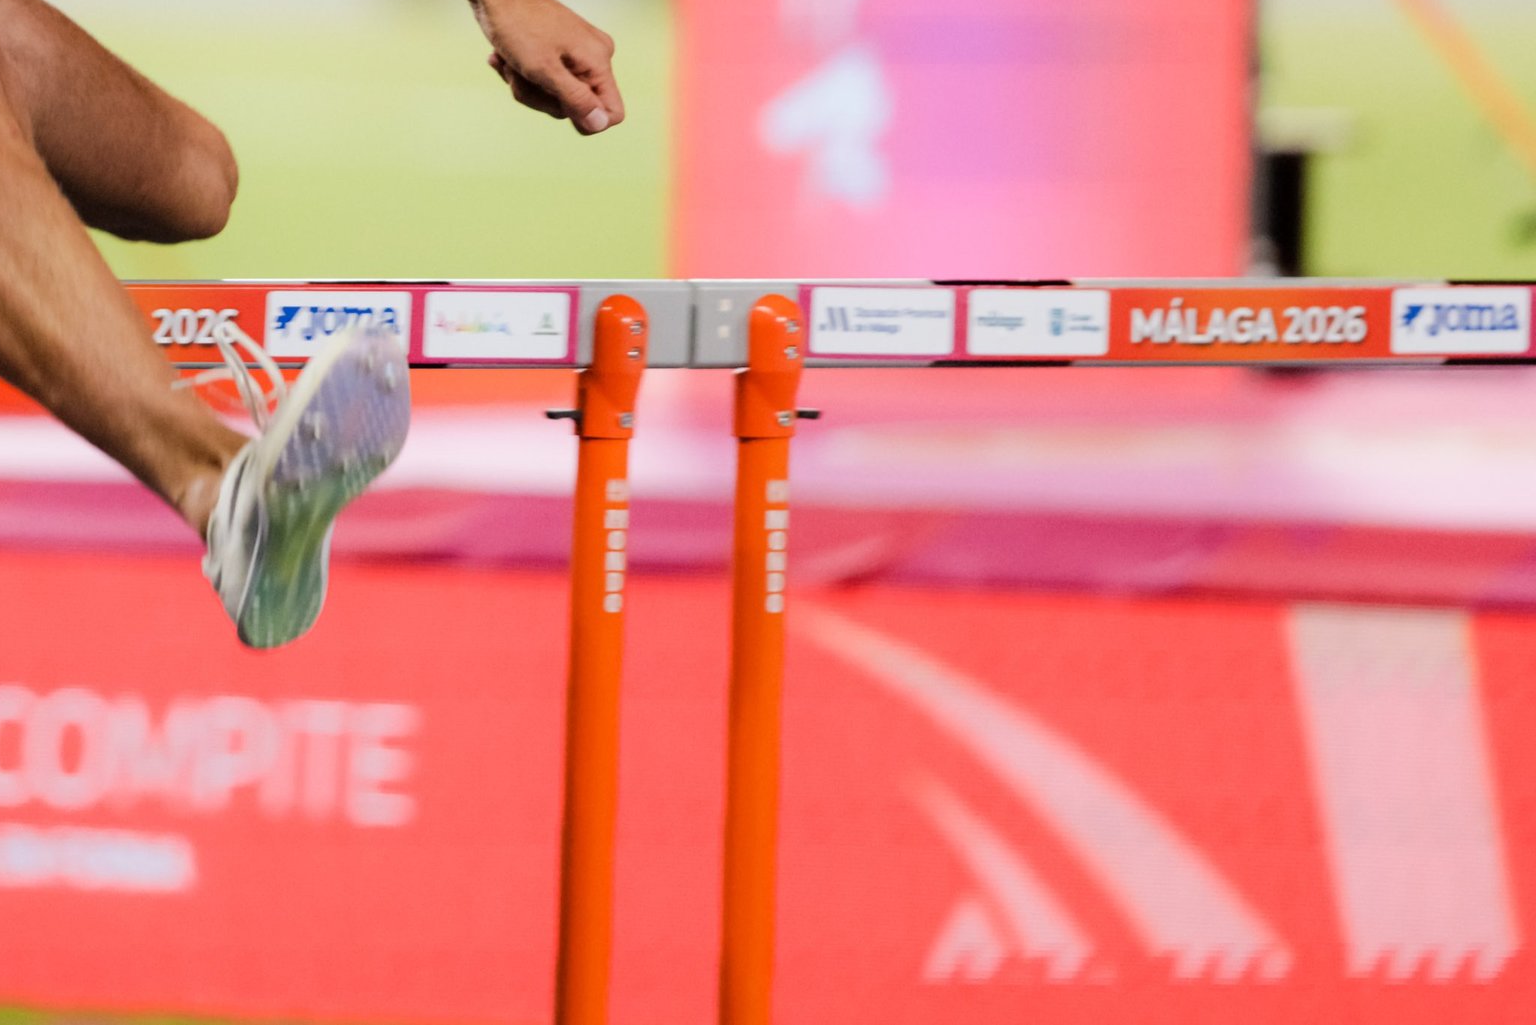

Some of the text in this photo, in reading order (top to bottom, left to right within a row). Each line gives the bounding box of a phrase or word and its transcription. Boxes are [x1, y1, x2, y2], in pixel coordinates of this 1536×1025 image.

[151, 308, 239, 345] 2026
[1130, 297, 1278, 343] MÁLAGA
[1282, 306, 1366, 343] 2026
